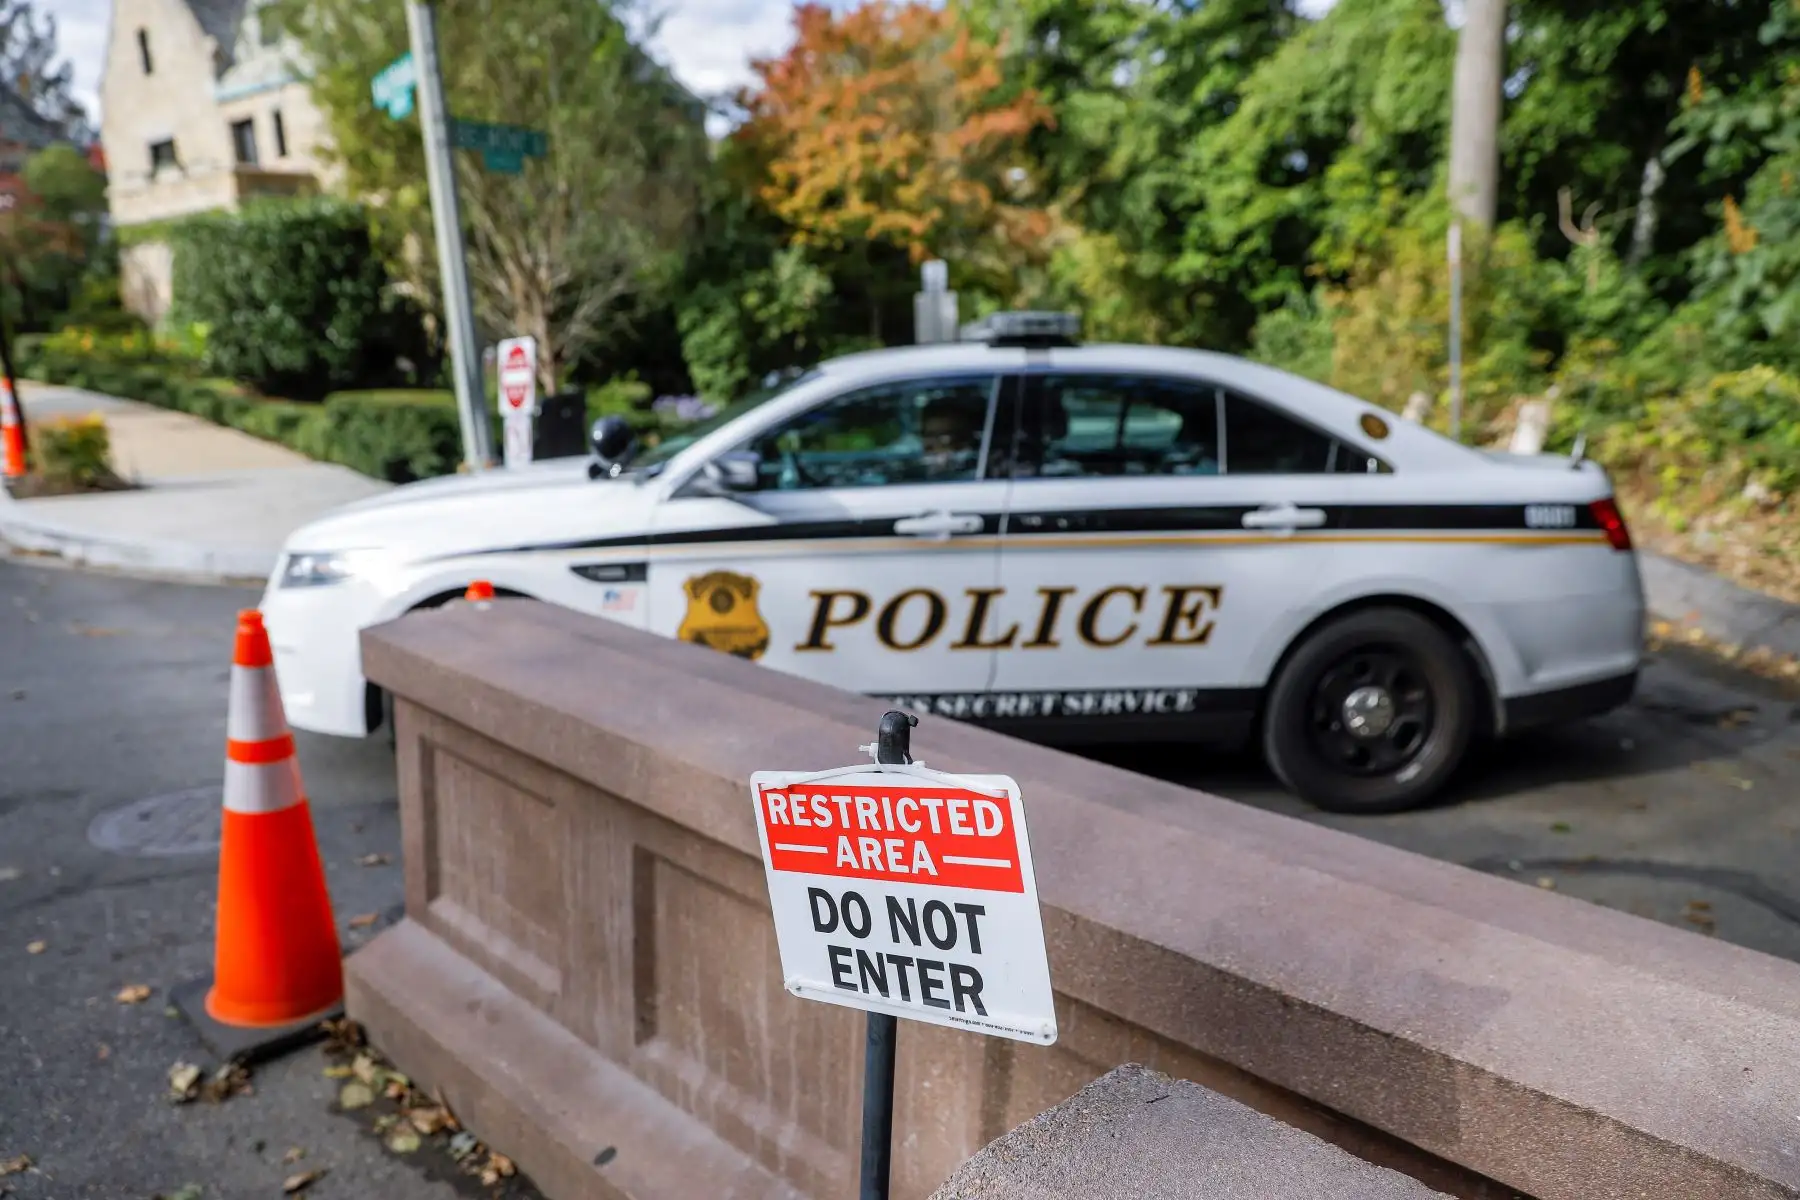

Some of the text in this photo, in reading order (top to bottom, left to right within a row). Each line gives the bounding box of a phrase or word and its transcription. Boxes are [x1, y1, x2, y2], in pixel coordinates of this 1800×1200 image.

[793, 584, 1225, 653] POLICE
[935, 692, 1060, 718] SECRET
[1062, 689, 1198, 716] SERVICE
[766, 793, 1004, 838] RESTRICTED
[836, 835, 938, 876] AREA
[807, 886, 985, 955] DO NOT
[827, 944, 988, 1017] ENTER
